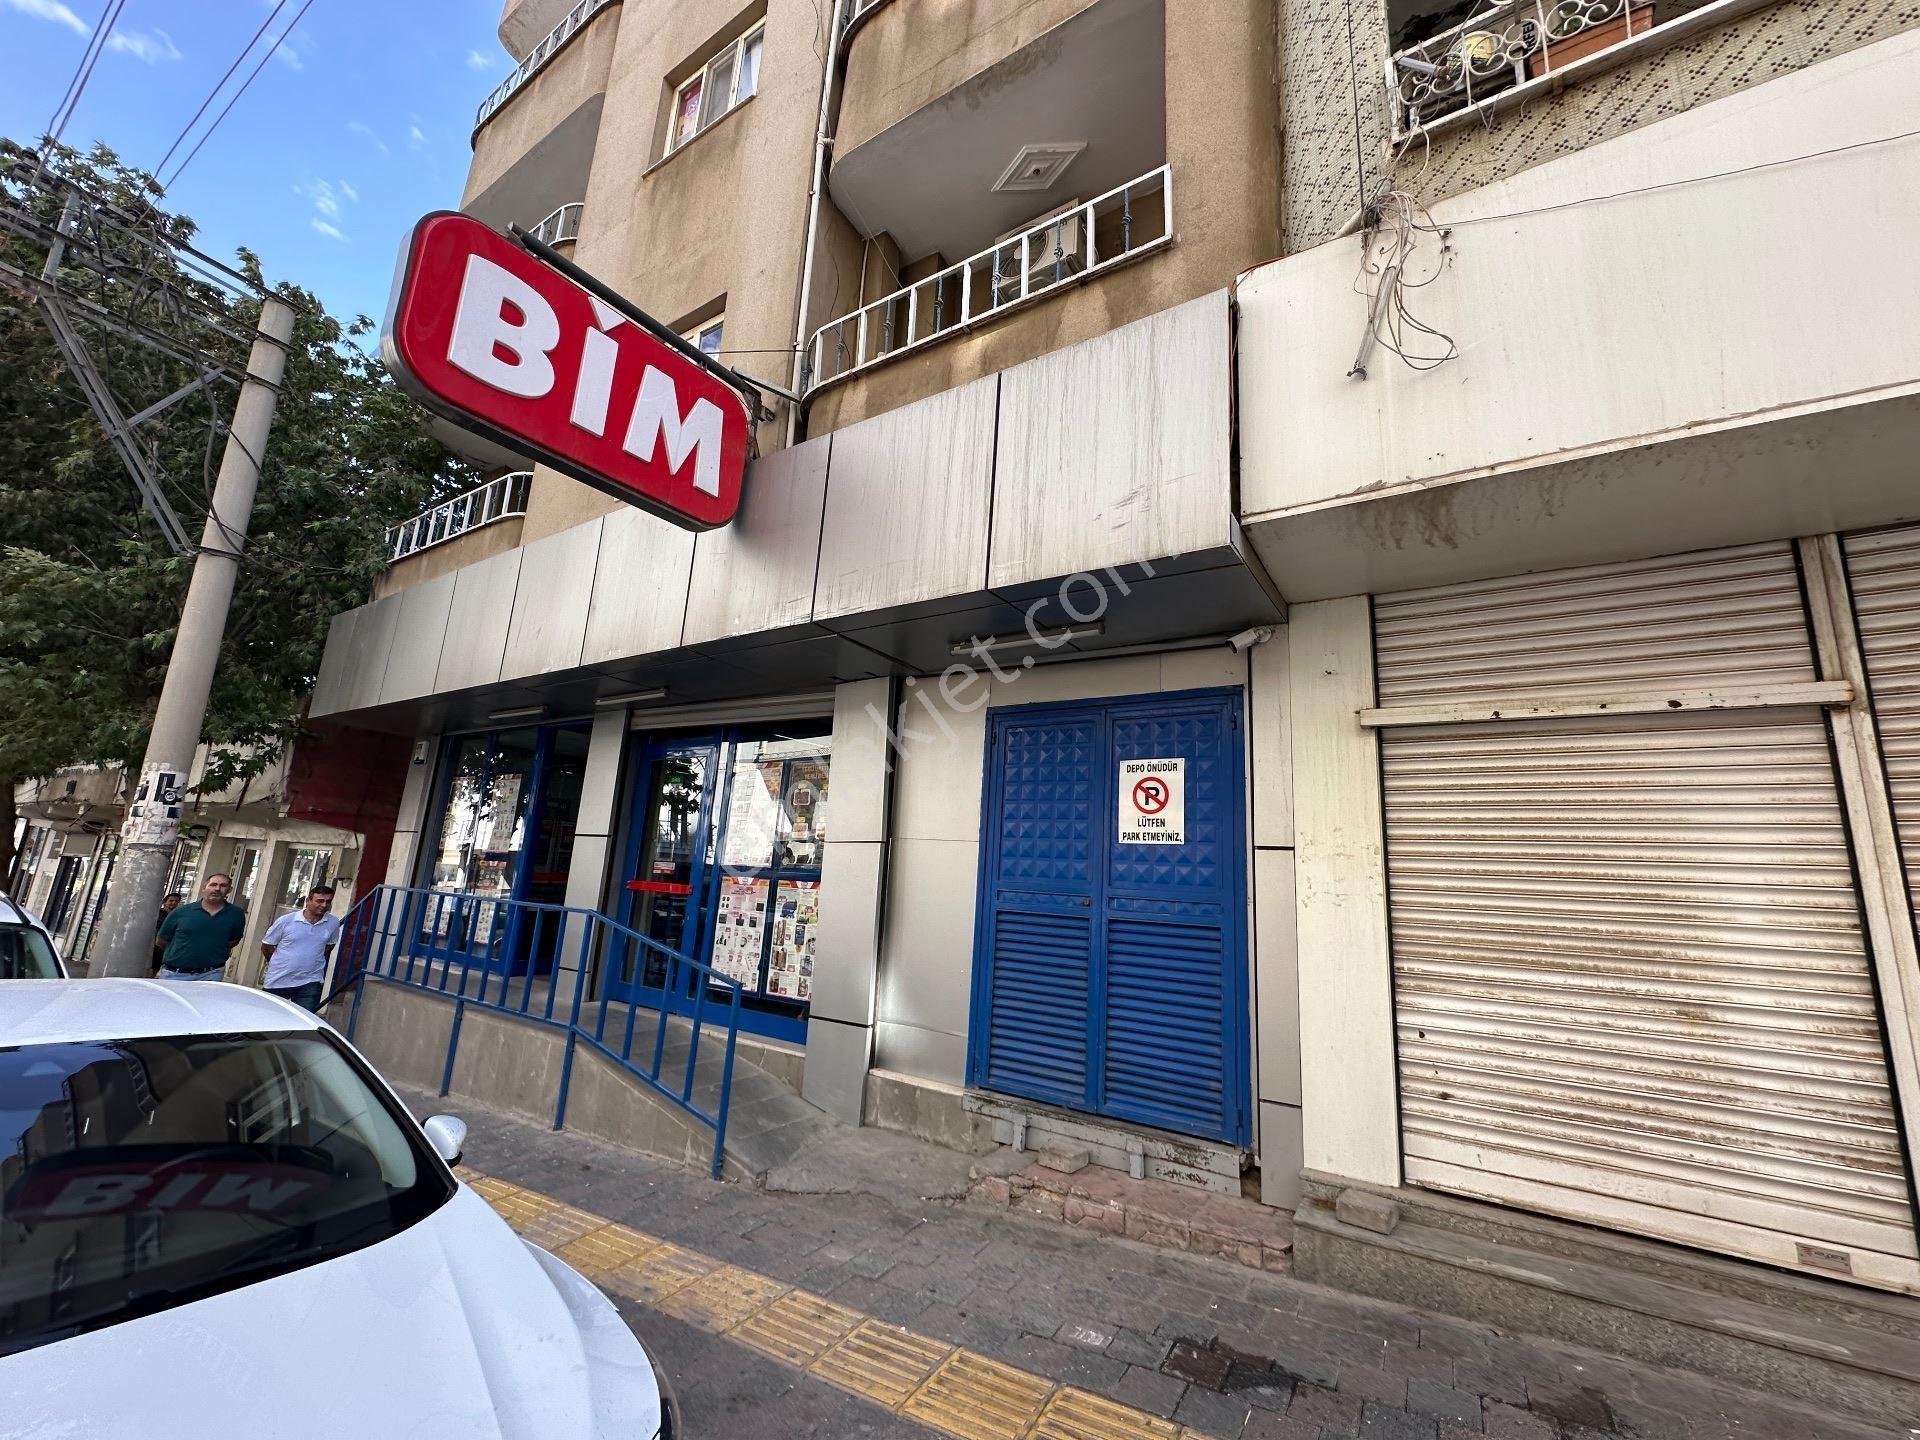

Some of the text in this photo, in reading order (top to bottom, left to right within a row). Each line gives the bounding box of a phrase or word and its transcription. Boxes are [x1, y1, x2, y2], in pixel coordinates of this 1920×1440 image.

[1126, 760, 1178, 773] DEPO ÖNÜDÜR
[1137, 815, 1166, 828] LÜTFEN
[1122, 831, 1141, 841] PARK
